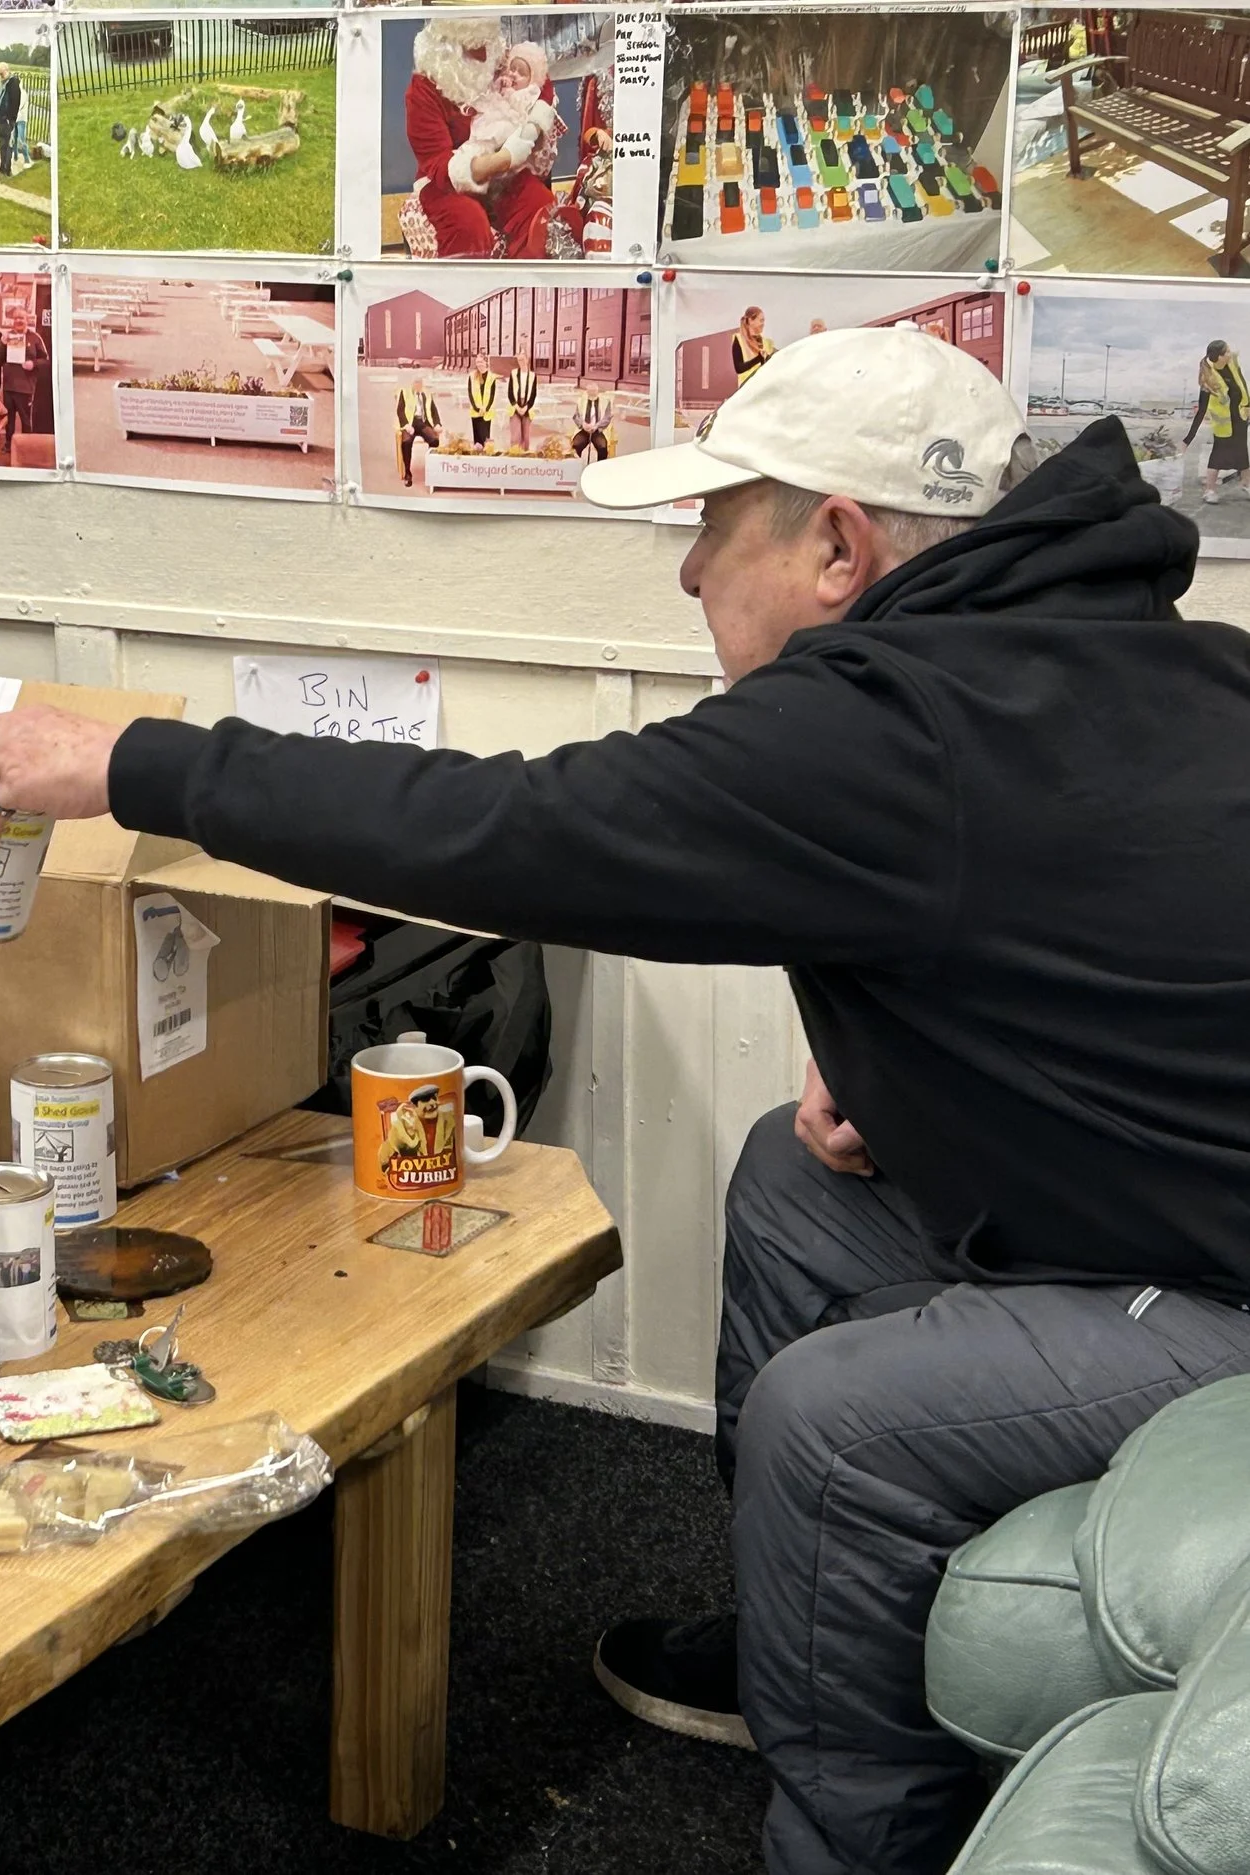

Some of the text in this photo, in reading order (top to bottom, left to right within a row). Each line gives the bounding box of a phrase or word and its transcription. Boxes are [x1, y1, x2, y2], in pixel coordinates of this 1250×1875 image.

[441, 462, 564, 480] The Shipyard Sanctuary
[298, 673, 368, 712] BIN
[314, 714, 426, 742] FOR THE
[391, 1153, 452, 1171] LOVELY
[399, 1167, 456, 1183] JUBBLY
